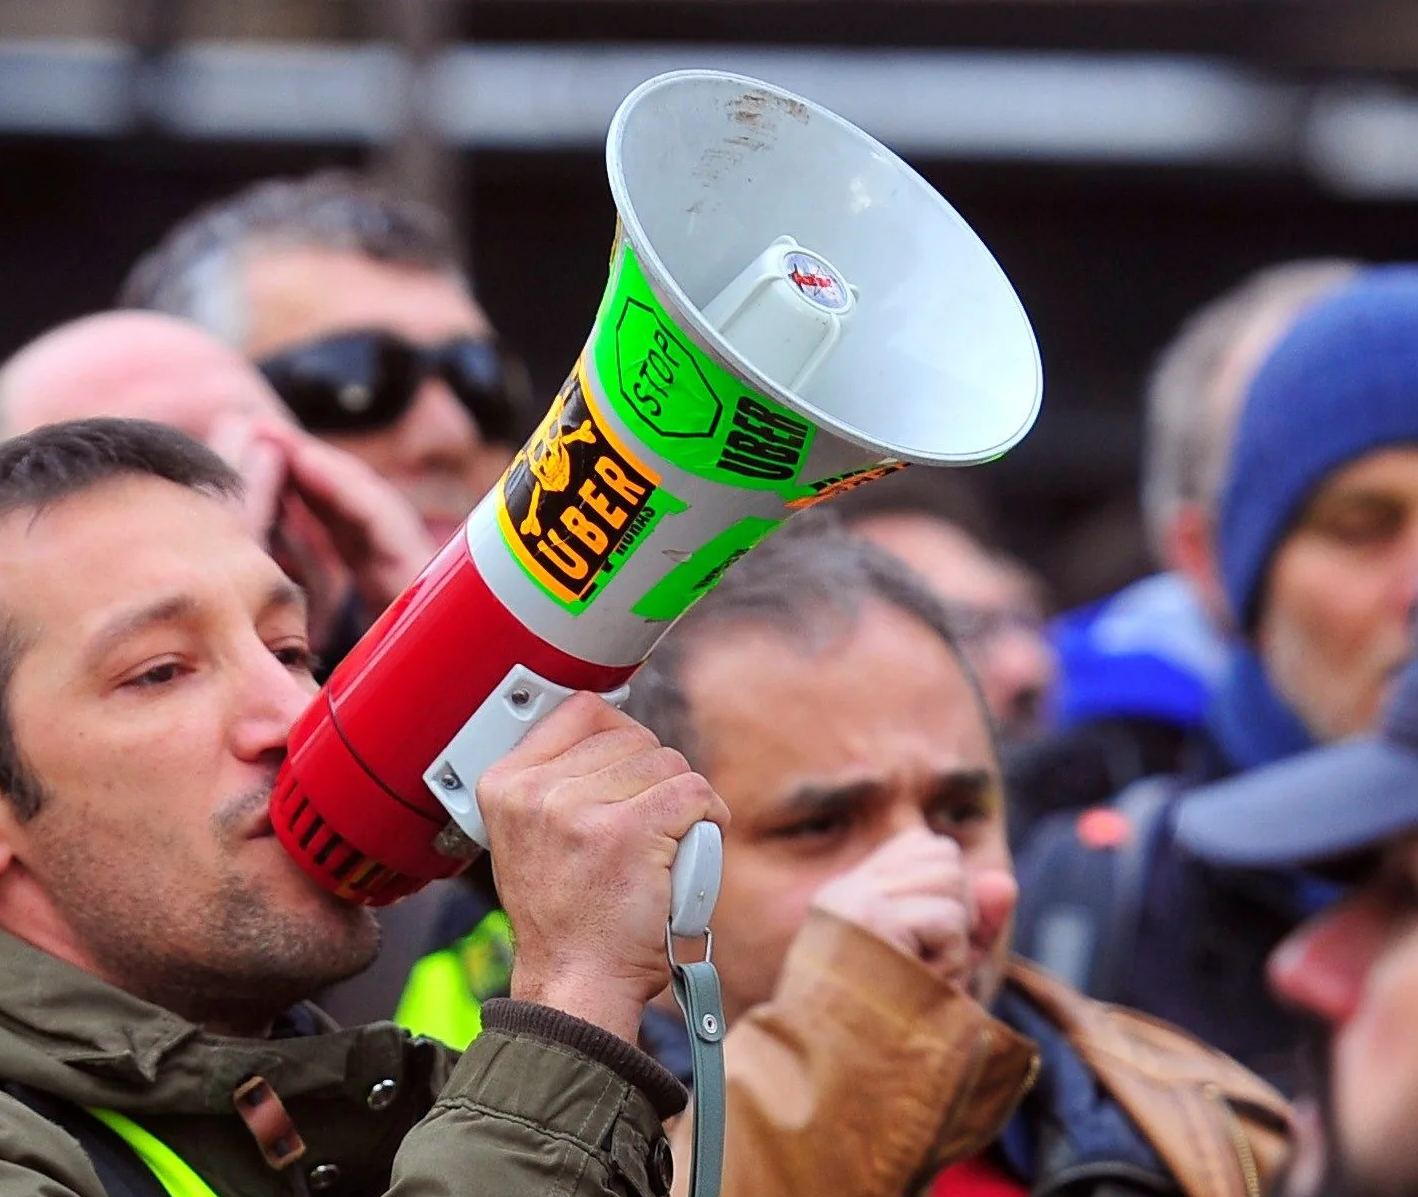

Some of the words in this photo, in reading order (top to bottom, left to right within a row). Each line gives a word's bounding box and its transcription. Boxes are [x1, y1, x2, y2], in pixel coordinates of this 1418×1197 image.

[632, 329, 679, 417] STOP
[717, 396, 809, 481] UBER
[538, 455, 647, 580] UBER
